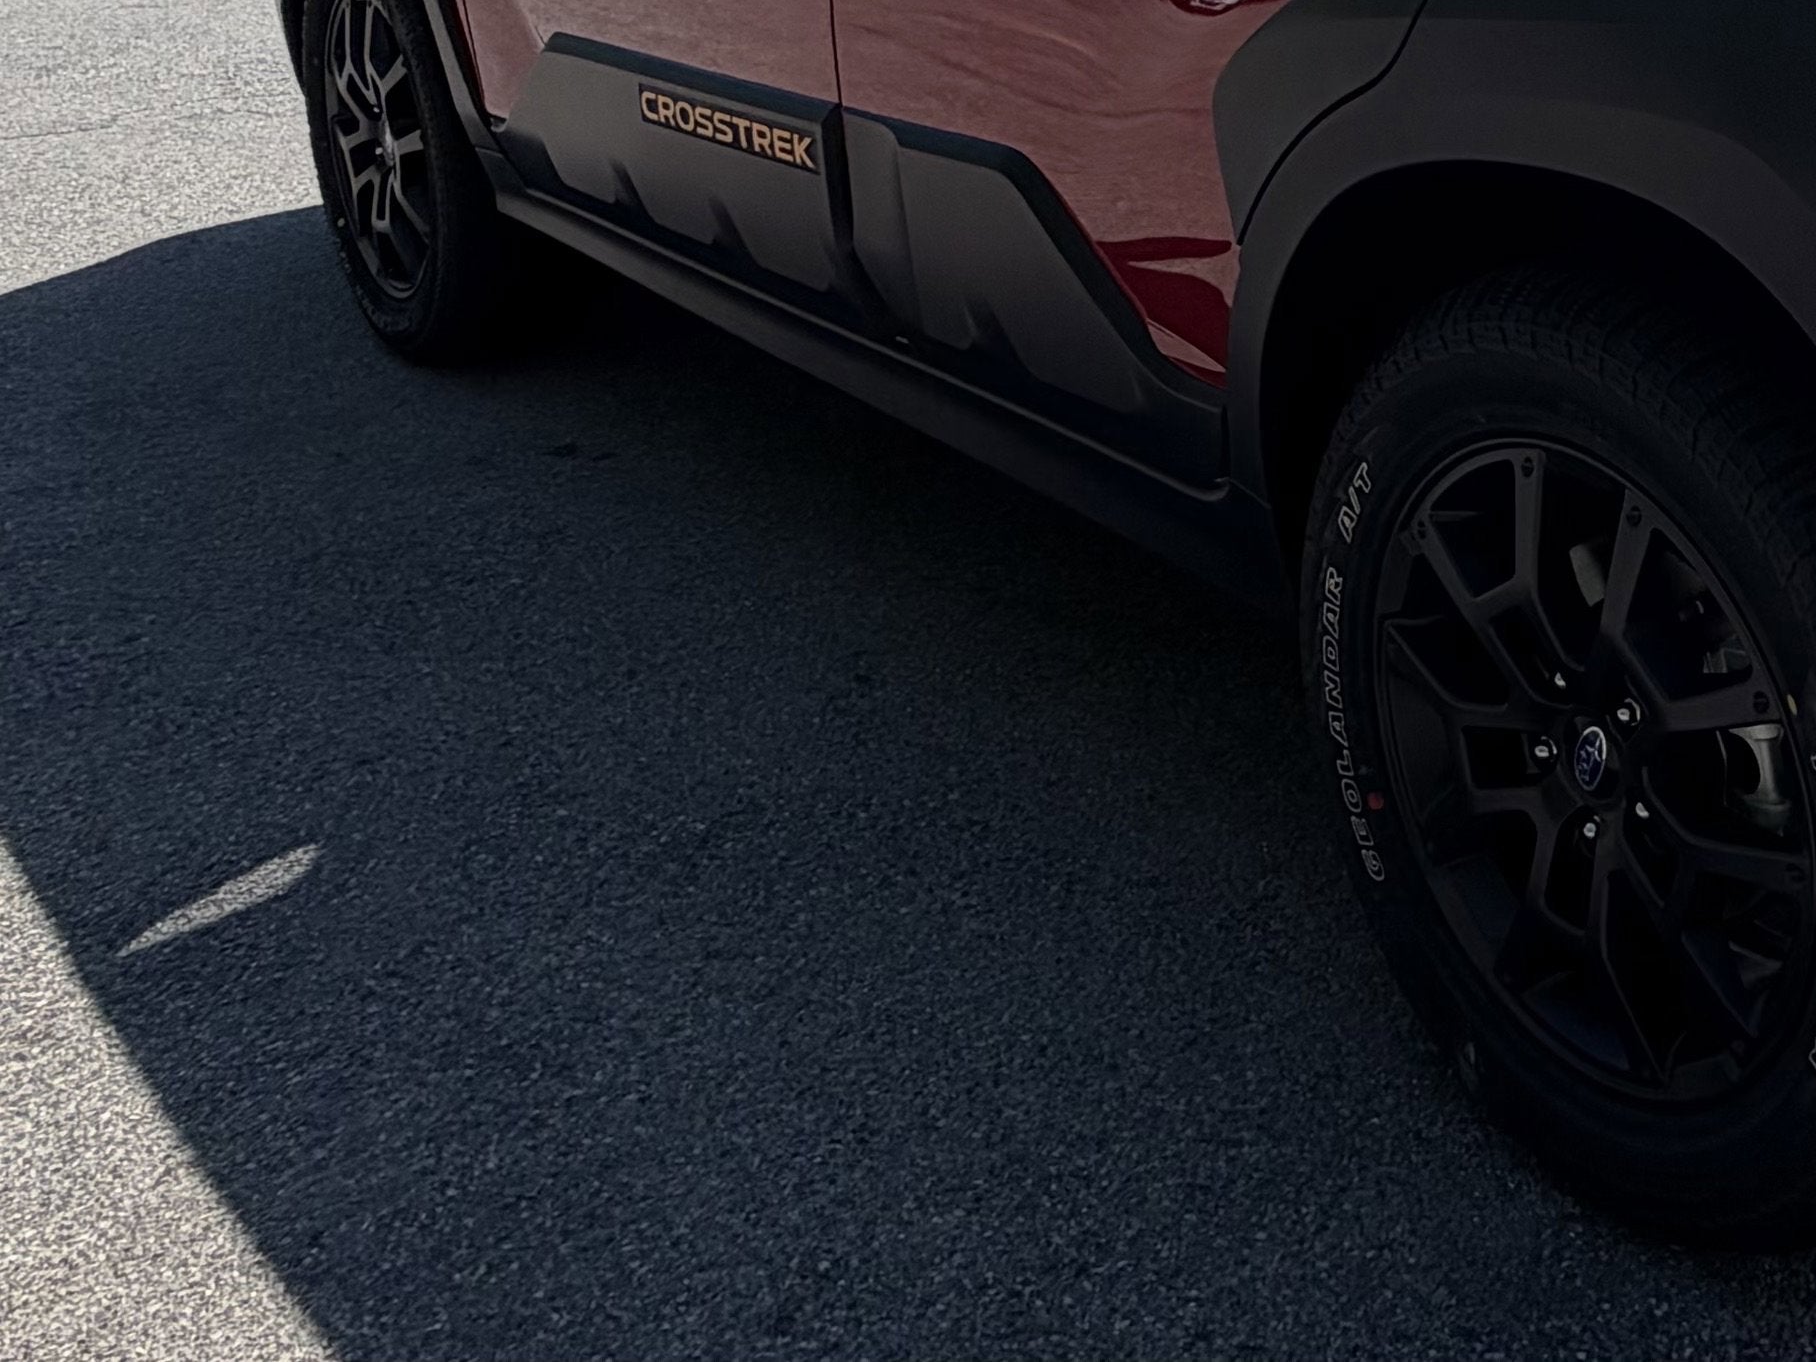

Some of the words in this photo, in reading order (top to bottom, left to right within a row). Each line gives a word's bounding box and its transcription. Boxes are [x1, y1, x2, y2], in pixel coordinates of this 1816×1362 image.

[641, 90, 816, 170] CROSSTREK
[1336, 462, 1374, 544] A/T
[1323, 566, 1386, 882] GEOLANDAR
